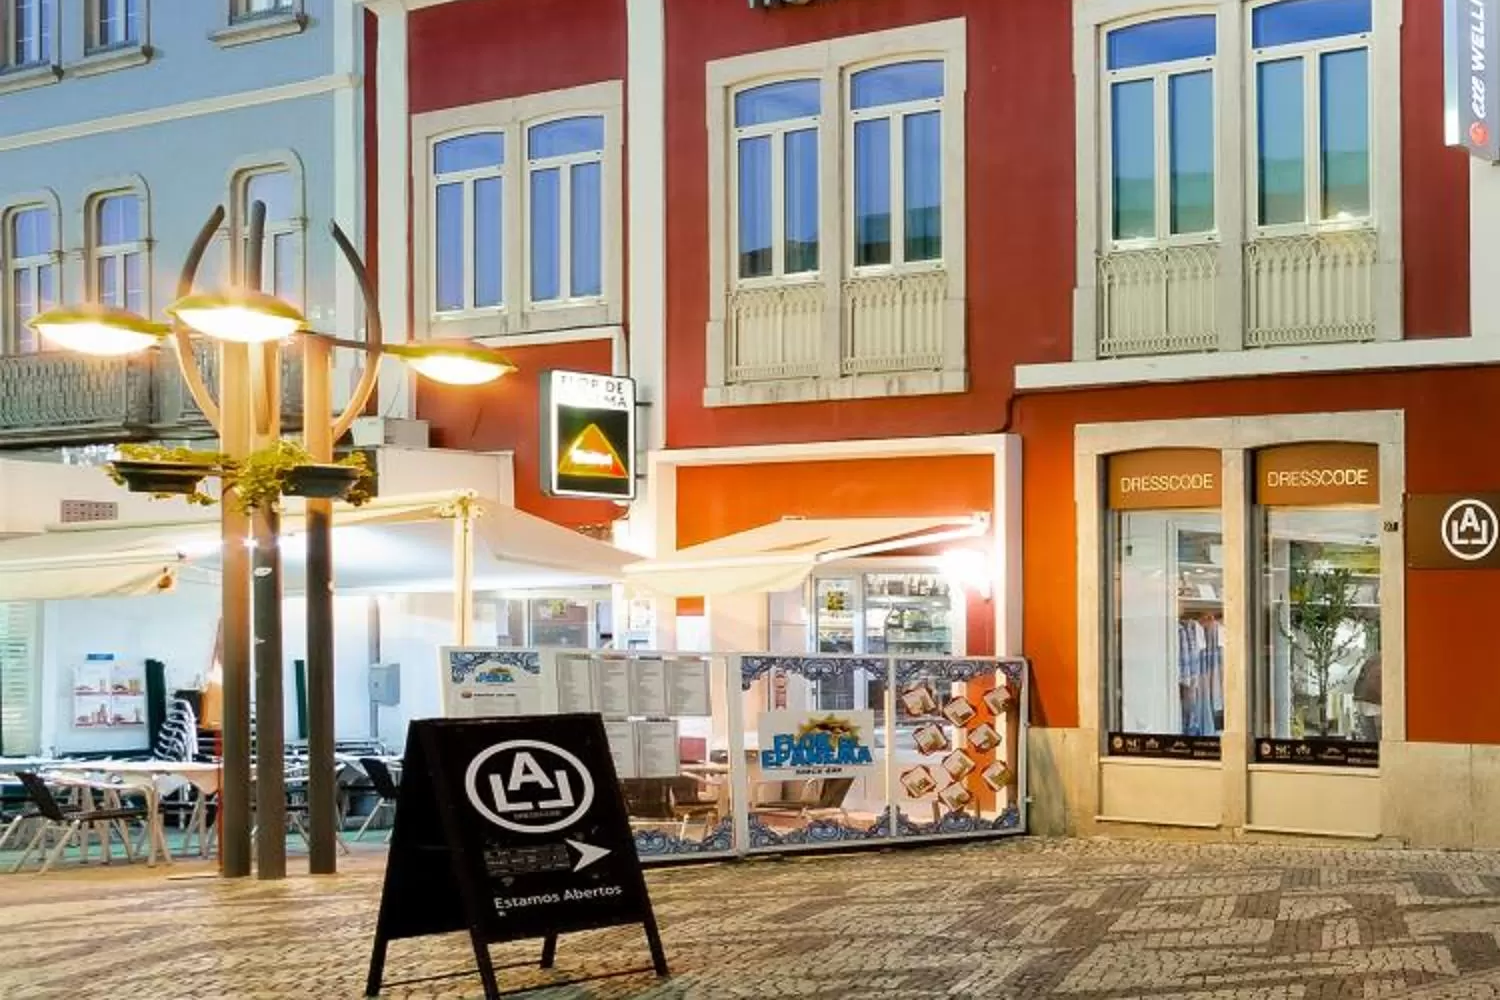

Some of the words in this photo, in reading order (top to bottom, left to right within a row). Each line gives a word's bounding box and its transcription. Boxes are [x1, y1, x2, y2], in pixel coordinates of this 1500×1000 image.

[1120, 474, 1213, 493] DRESSCODE
[1267, 469, 1369, 488] DRESSCODE
[494, 892, 560, 909] Estamos
[563, 884, 623, 901] Abertos
